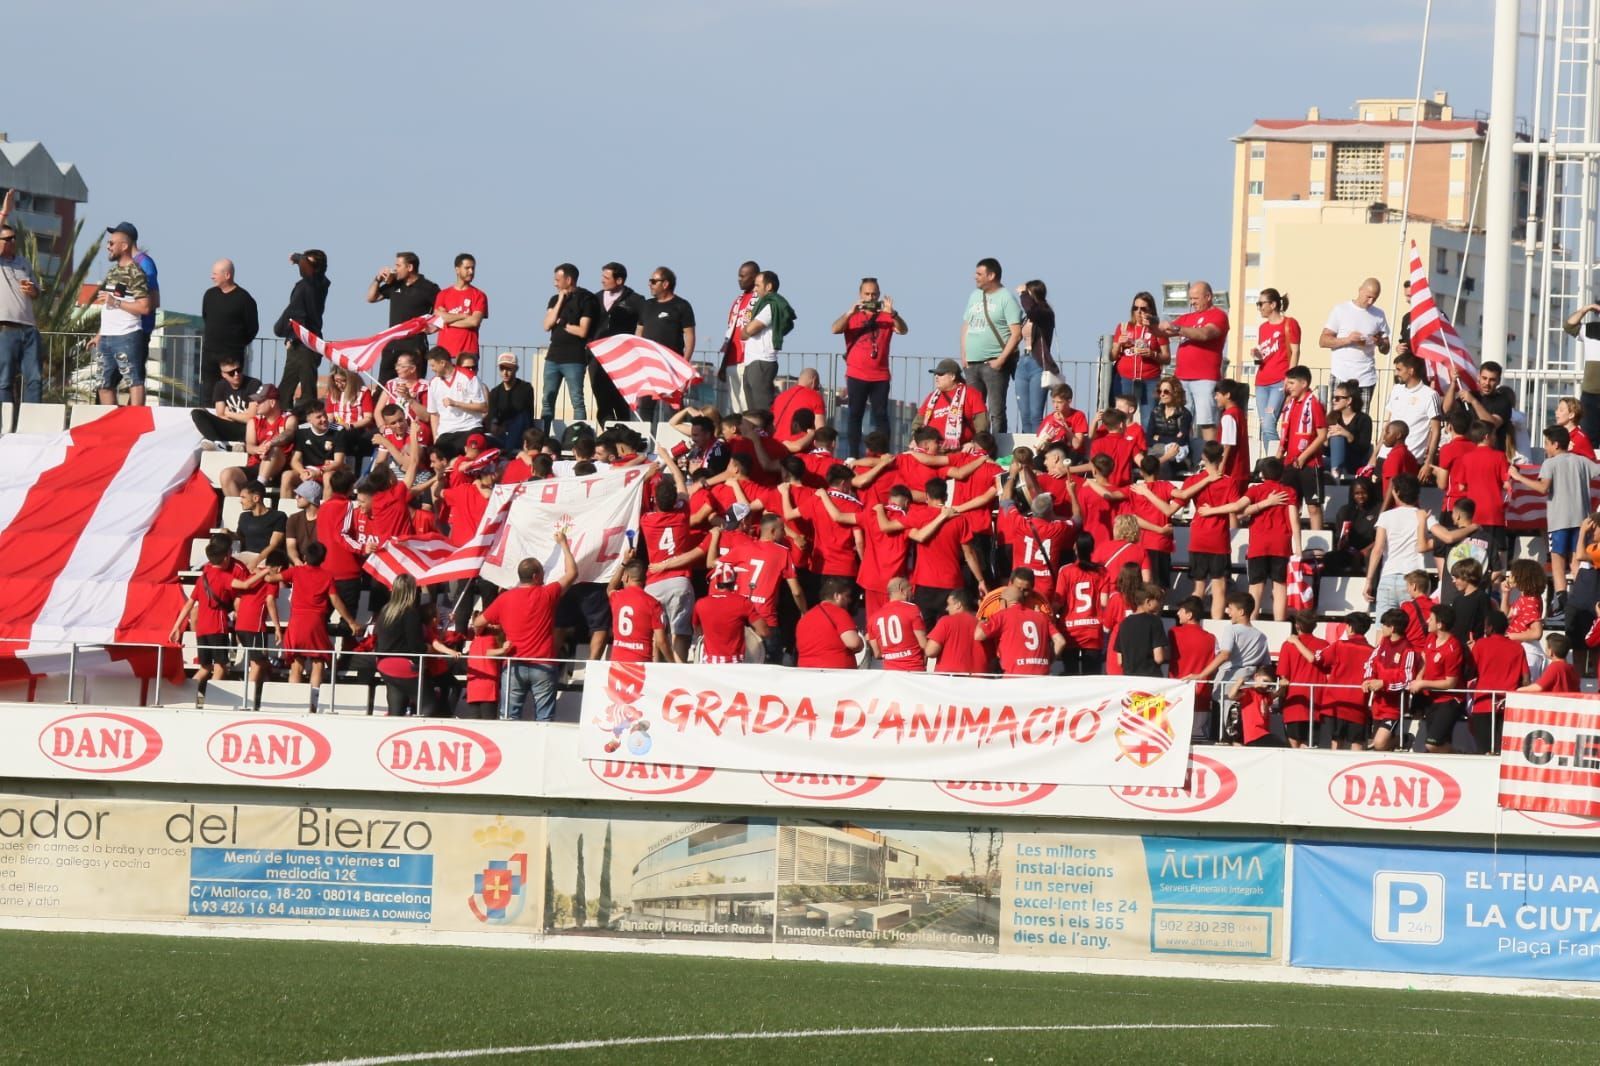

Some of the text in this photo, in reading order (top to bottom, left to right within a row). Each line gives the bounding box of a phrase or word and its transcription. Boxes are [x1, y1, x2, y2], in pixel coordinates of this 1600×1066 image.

[659, 527, 676, 555] 4
[1023, 535, 1051, 565] 14
[749, 558, 765, 587] 7
[1075, 581, 1093, 613] 5
[618, 605, 635, 637] 6
[877, 614, 903, 648] 10
[1022, 620, 1039, 650] 9
[661, 687, 1113, 749] GRADA D'ANIMACIÓ
[51, 726, 134, 761] DANI
[219, 733, 303, 767] DANI
[389, 739, 473, 773] DANI
[1342, 773, 1431, 809] DANI
[166, 804, 237, 844] del
[297, 806, 432, 850] Bierzo
[224, 850, 401, 868] Menú de lunes a viernes al
[1017, 843, 1097, 859] Les millors
[266, 867, 357, 882] mediodía 12€
[1015, 877, 1094, 894] i un servei
[1465, 871, 1492, 890] EL
[1498, 872, 1544, 891] TEU
[191, 886, 207, 899] C/
[276, 887, 312, 901] 18-20
[364, 891, 431, 904] Barcelona
[1092, 899, 1113, 913] les
[1118, 900, 1138, 913] 24
[201, 900, 432, 920] 93 426 16 84 ABIERTO DE LUNES A DOMINGO
[1388, 881, 1428, 933] P
[1466, 903, 1507, 928] LA
[620, 920, 765, 935] Tanatori L'Hospitalet Ronda
[1014, 912, 1124, 930] hores i els 365
[1160, 920, 1183, 931] 902
[1186, 921, 1209, 932] 230
[1212, 922, 1235, 933] 238
[1407, 921, 1433, 933] 24h
[950, 933, 974, 944] Gran
[976, 933, 995, 945] Via
[1014, 930, 1044, 944] dies
[1049, 932, 1067, 945] de
[1498, 936, 1551, 958] Plaça
